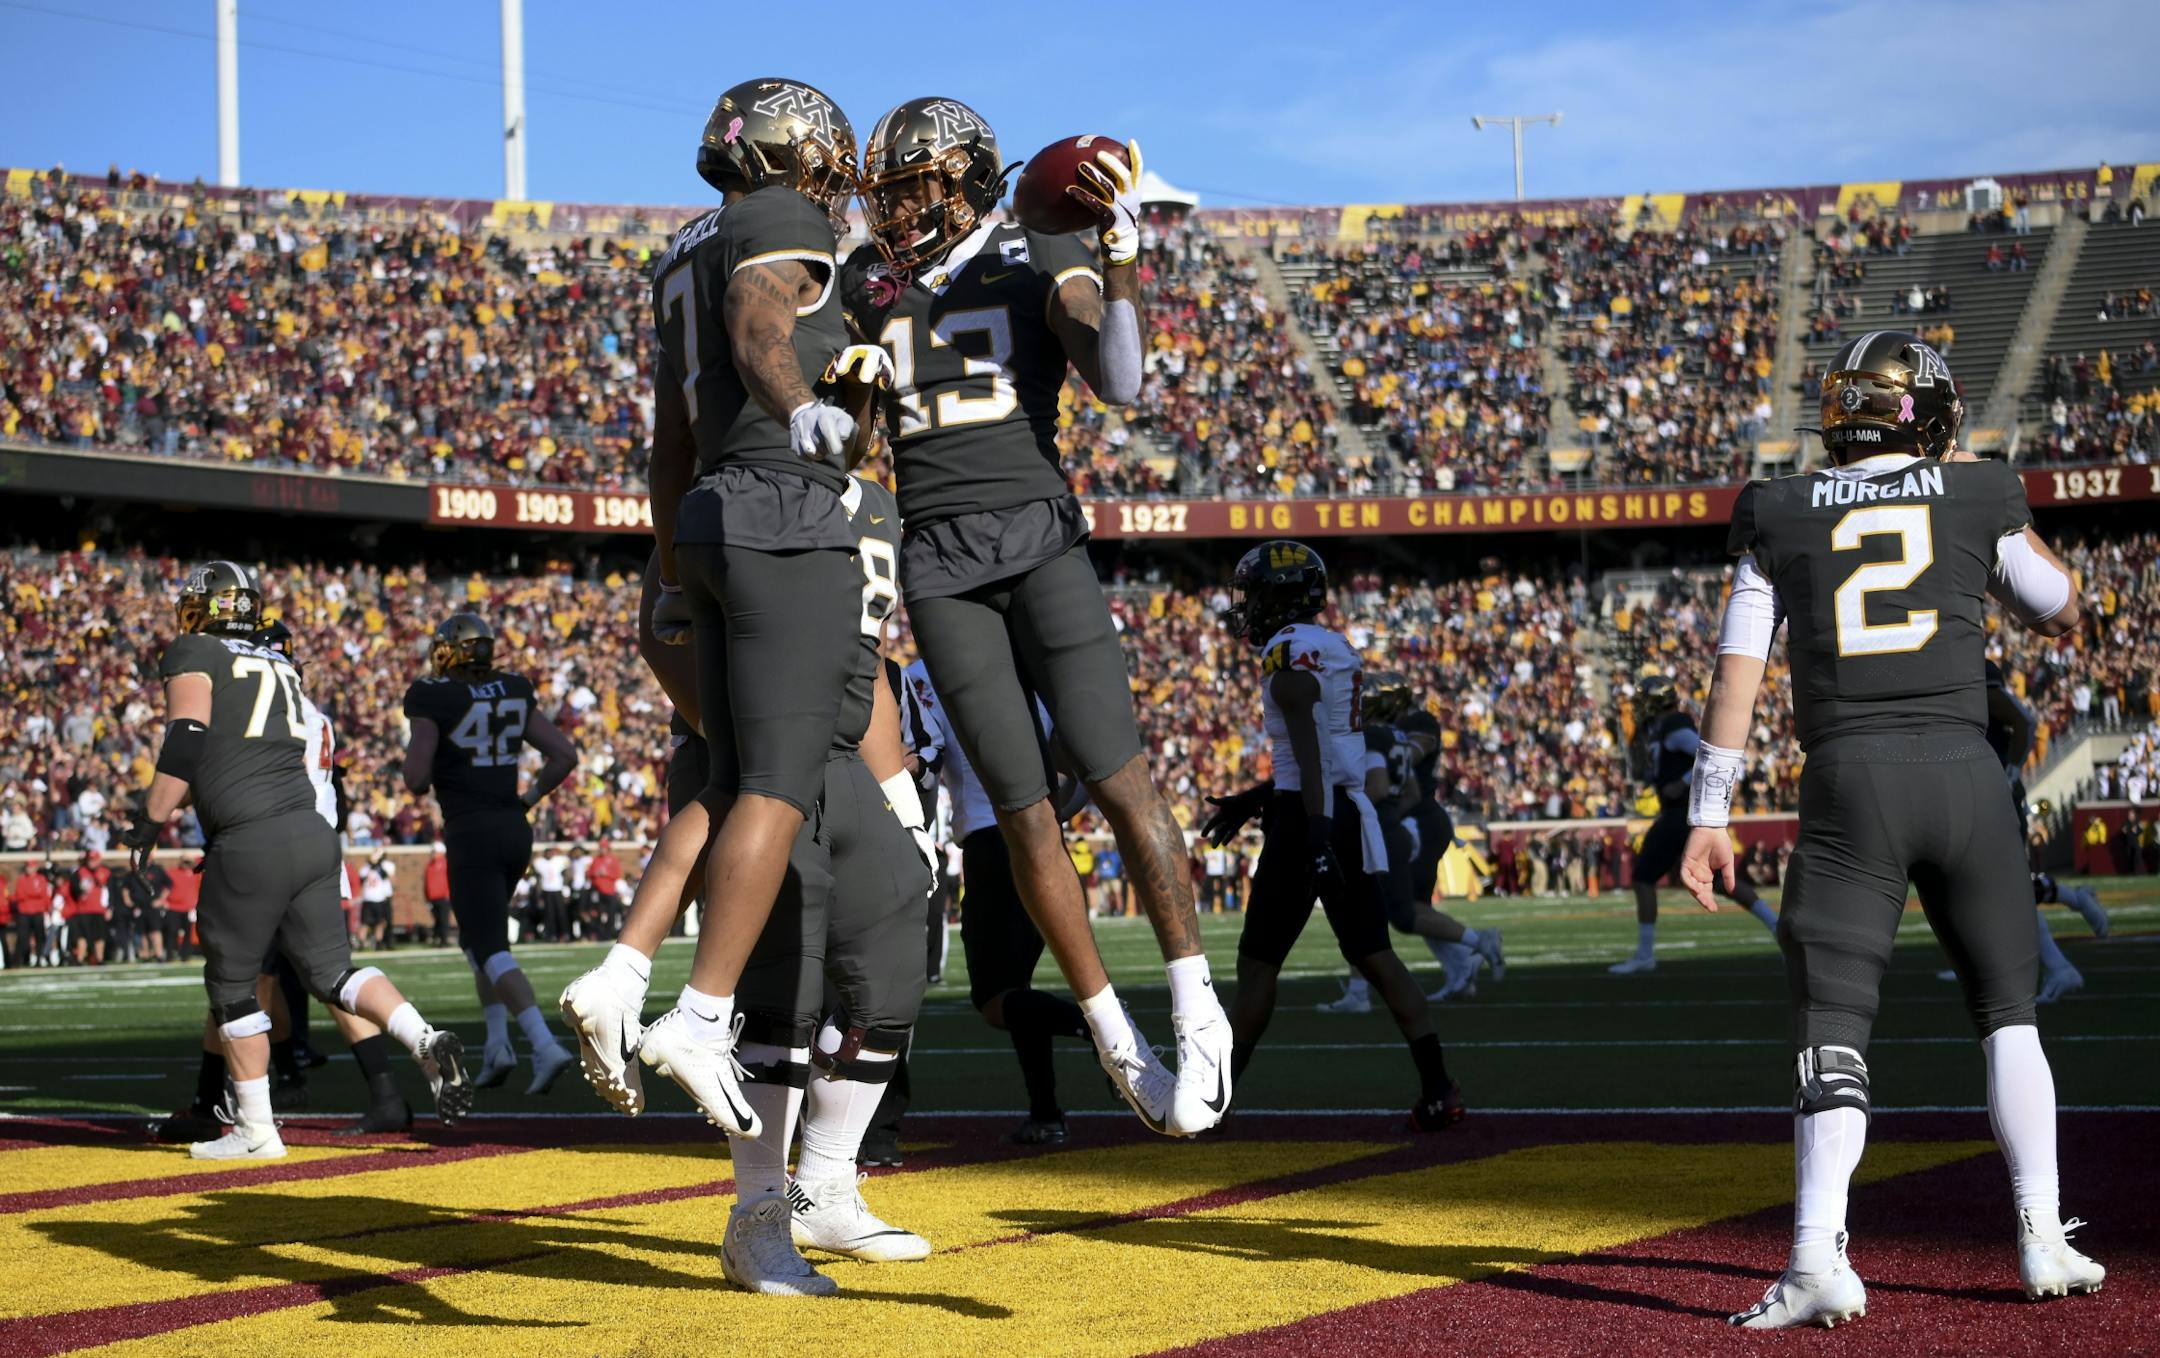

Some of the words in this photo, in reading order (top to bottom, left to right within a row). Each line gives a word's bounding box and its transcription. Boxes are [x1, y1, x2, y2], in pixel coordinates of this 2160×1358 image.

[662, 259, 700, 425] 7
[879, 304, 1018, 437] 13
[1811, 466, 1944, 508] MORGAN
[2052, 468, 2122, 499] 1937
[437, 487, 497, 520] 1900
[515, 492, 574, 525] 1903
[1119, 504, 1188, 532] 1927
[1229, 504, 1292, 530] BIG
[1315, 502, 1380, 528] TEN
[1407, 492, 1708, 527] CHAMPIONSHIPS
[1831, 504, 1938, 658] 2
[449, 697, 528, 767] 42
[786, 1181, 816, 1216] NIKE
